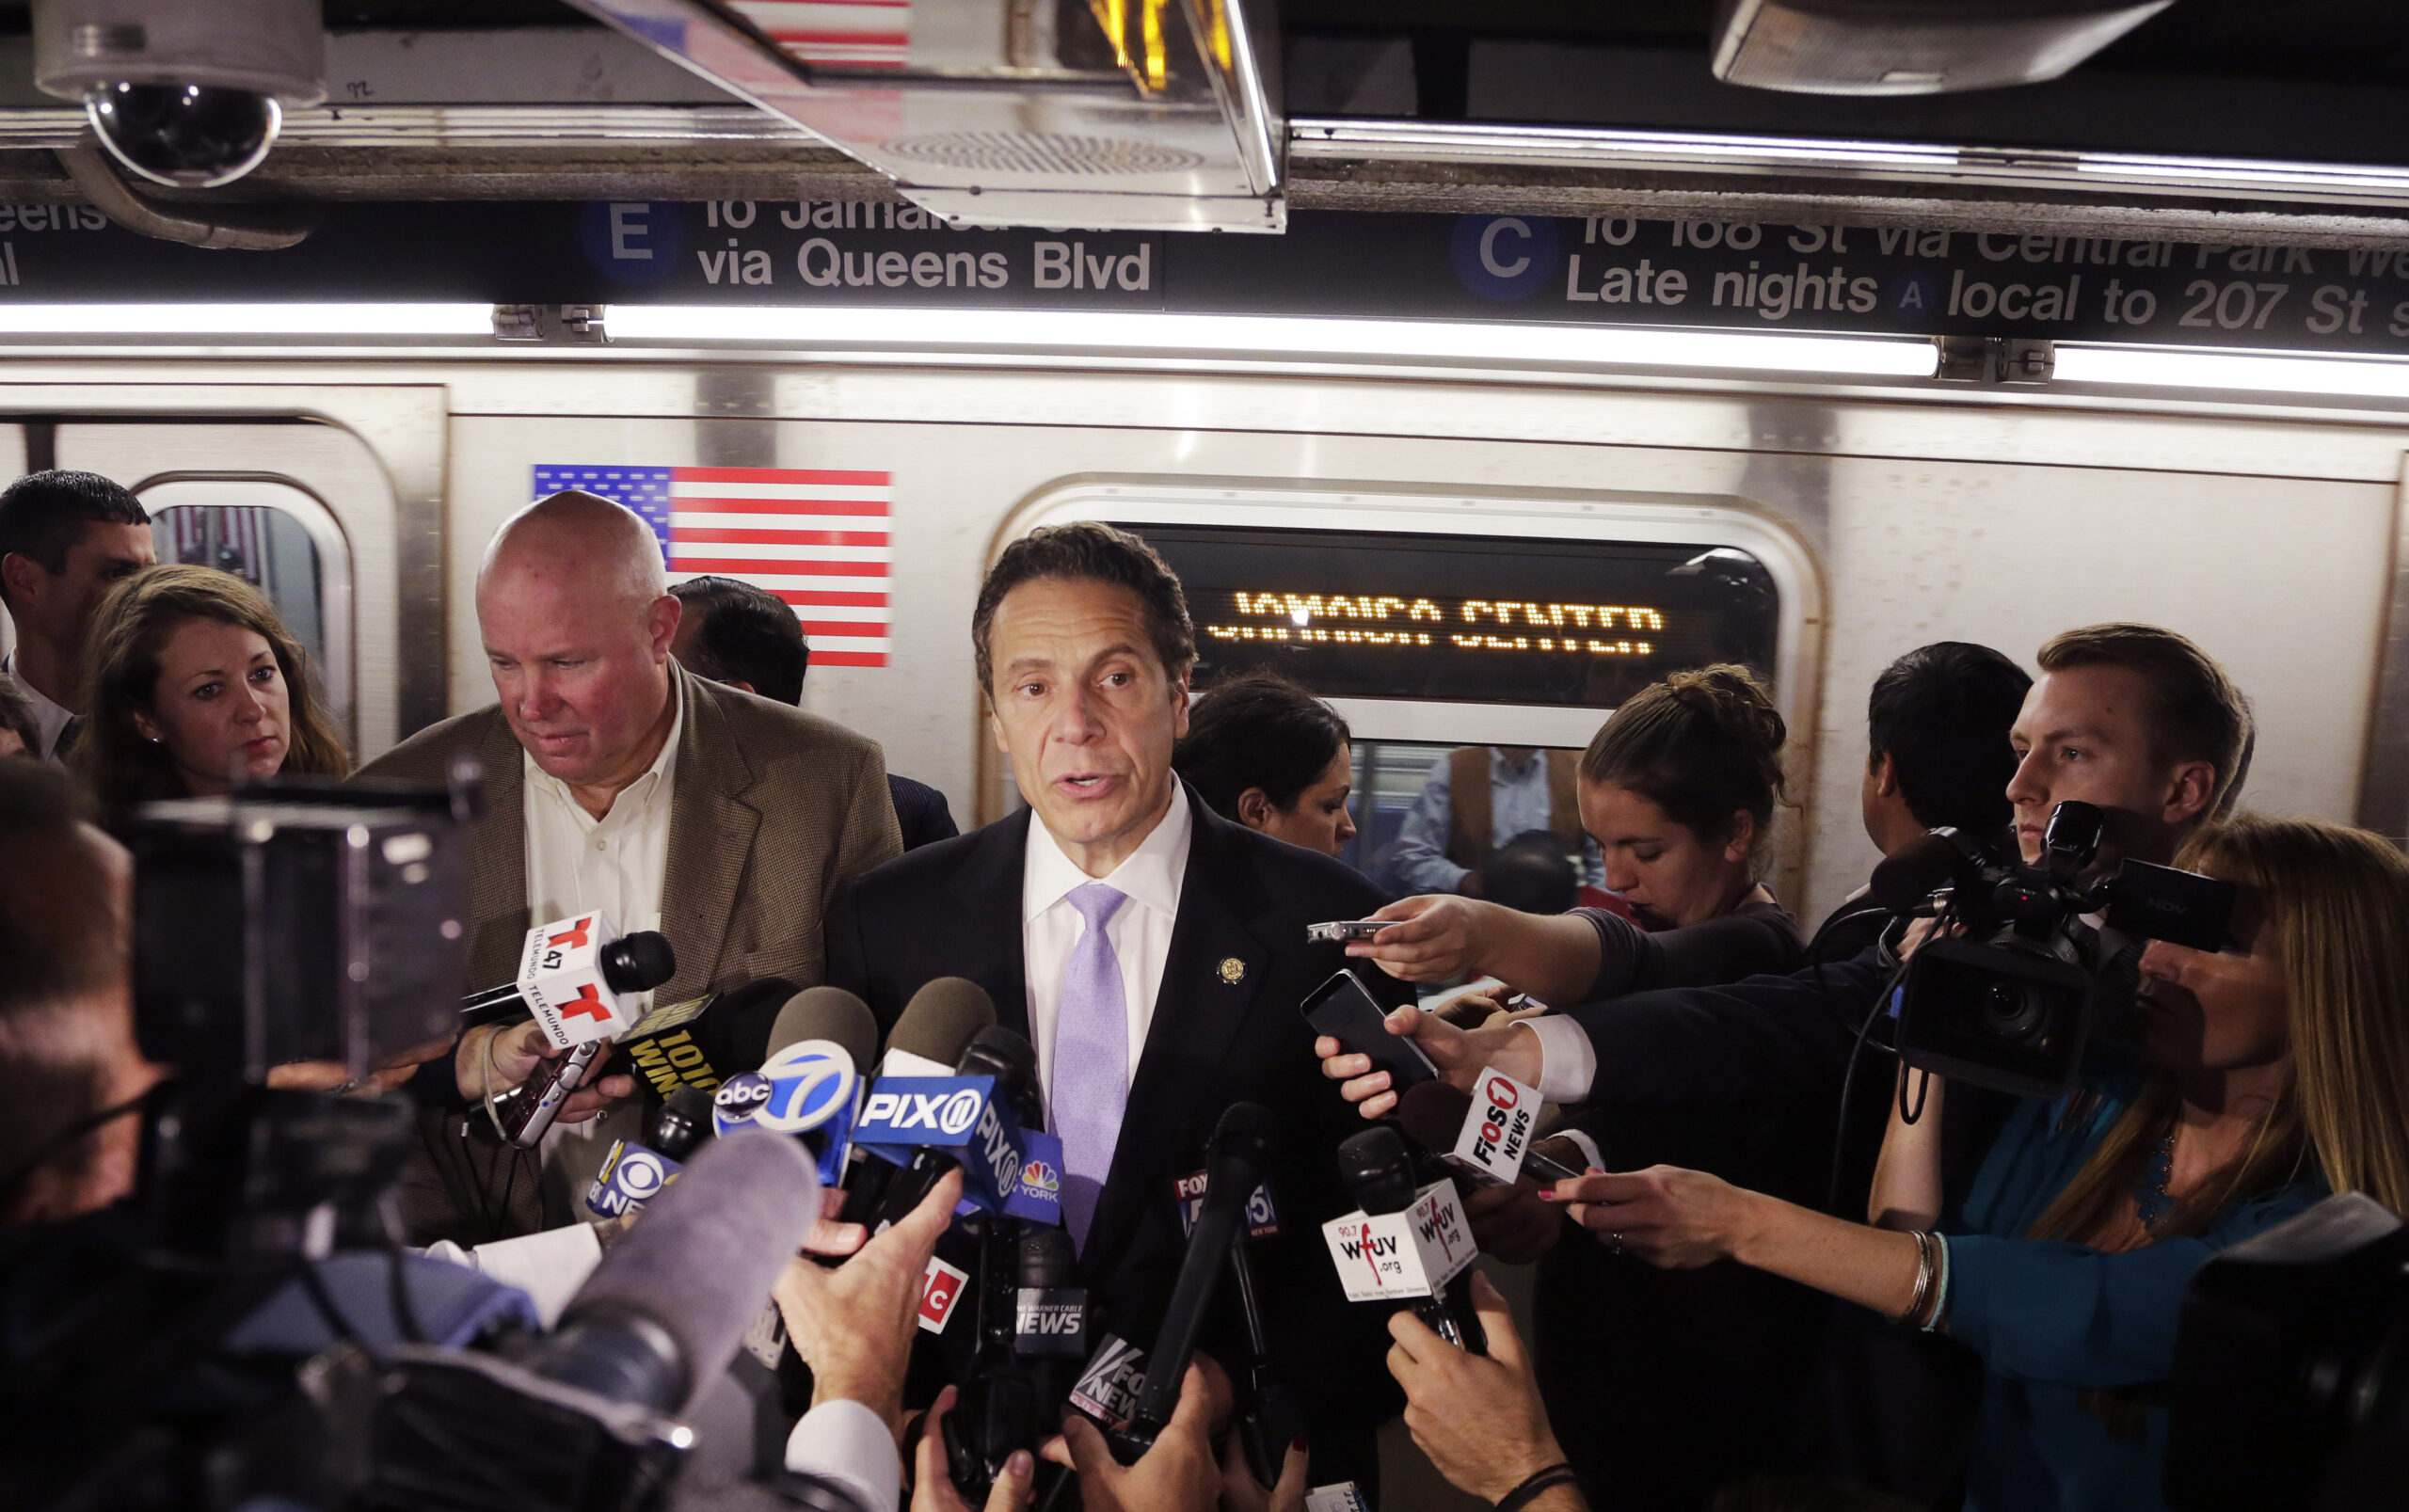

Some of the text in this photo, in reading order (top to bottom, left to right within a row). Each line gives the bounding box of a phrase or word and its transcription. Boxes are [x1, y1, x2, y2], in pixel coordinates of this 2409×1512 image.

[610, 202, 653, 260] E
[780, 200, 1009, 232] Jama
[697, 237, 1150, 291] via Queens Blvd
[1479, 217, 1532, 279] C
[1567, 254, 1688, 305] Late
[1712, 261, 1877, 321] nights
[1899, 280, 1923, 309] A
[1947, 269, 2082, 322] local
[2103, 279, 2156, 326] to
[2178, 279, 2289, 329] 207
[2306, 284, 2369, 334] St
[526, 928, 545, 980] TELEMUNDO
[542, 949, 563, 970] 47
[528, 984, 568, 1046] TELEMUNDO
[630, 1039, 684, 1101] WIN
[714, 1079, 771, 1106] abc
[1504, 1109, 1530, 1161] NEWS
[1020, 1185, 1059, 1203] YORK
[1016, 1313, 1082, 1334] NEWS
[1060, 1304, 1083, 1313] CABLE
[1086, 1376, 1137, 1419] NEW
[1112, 1362, 1146, 1396] FO
